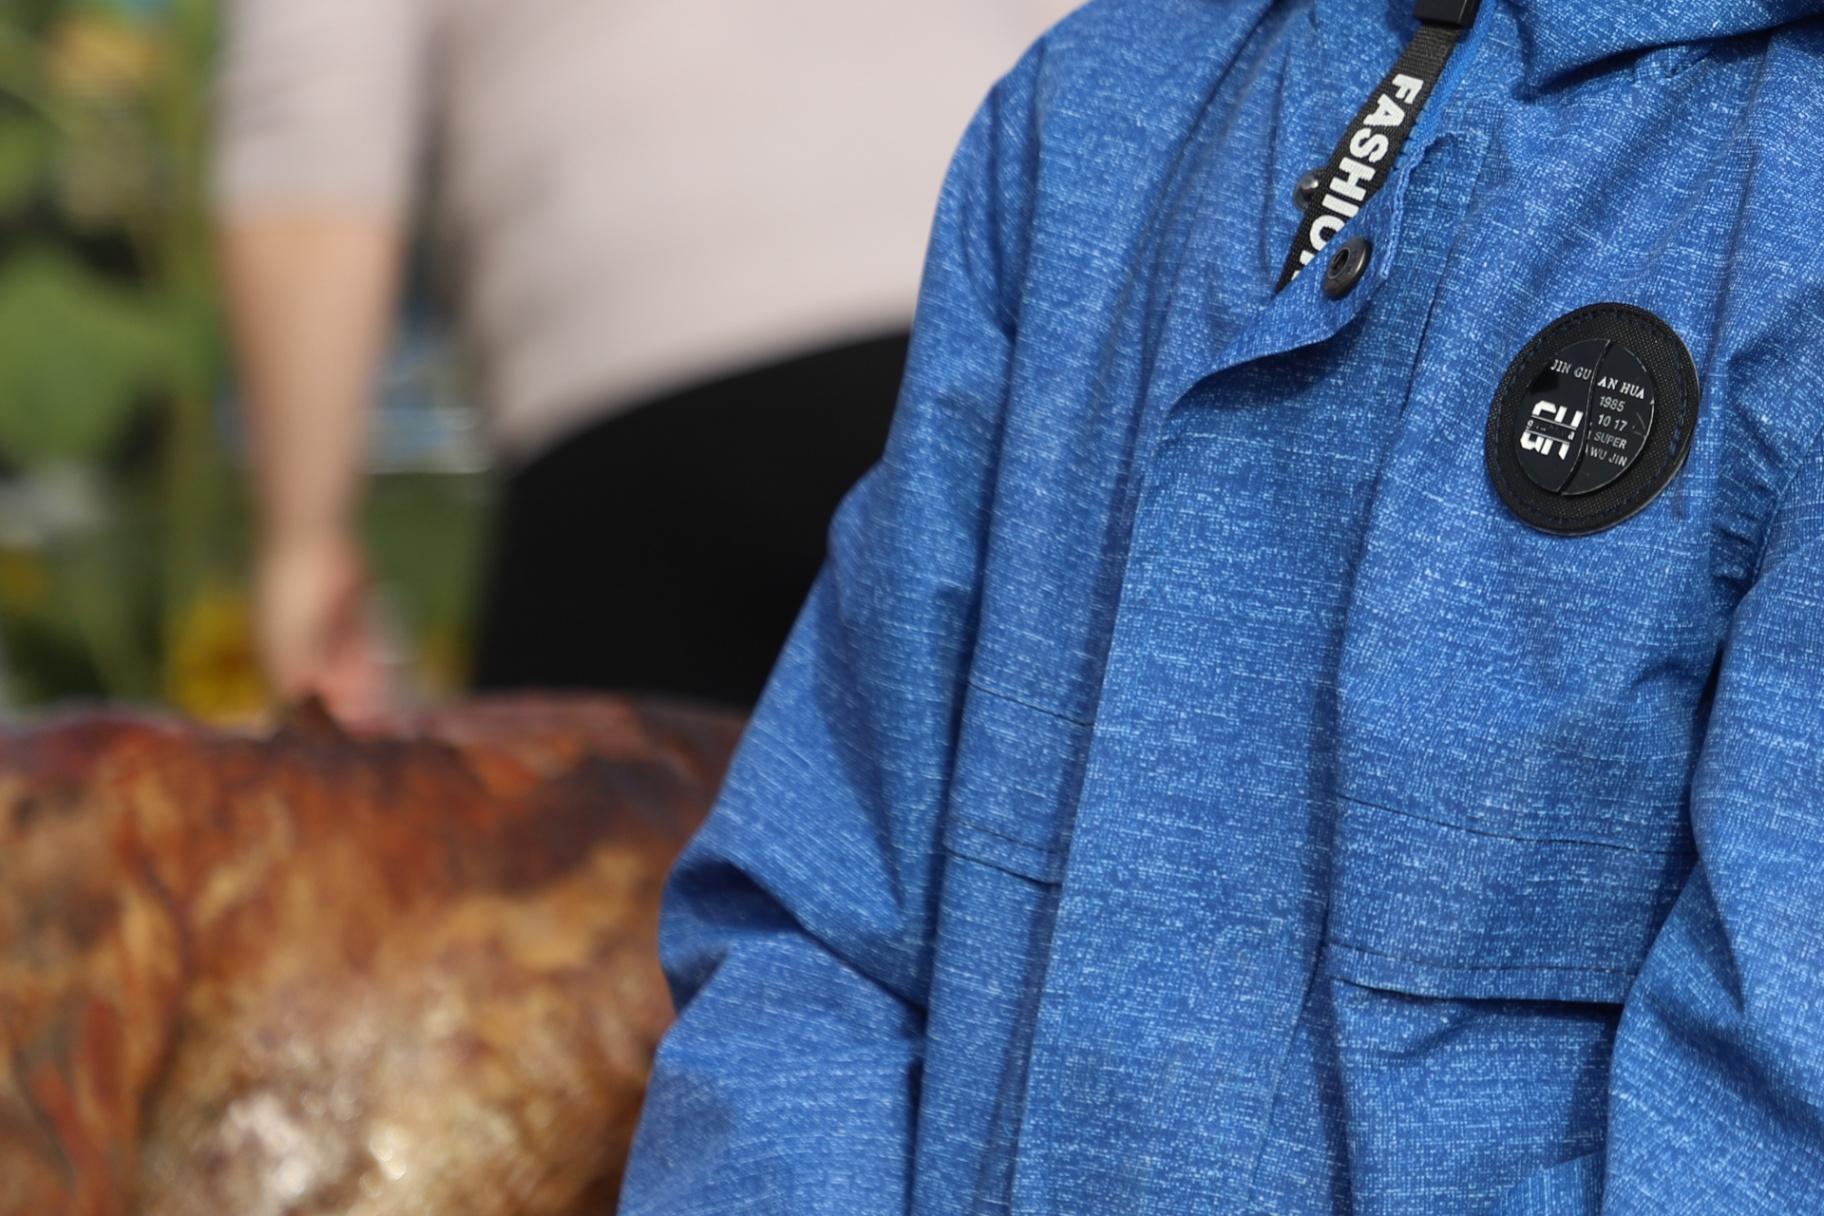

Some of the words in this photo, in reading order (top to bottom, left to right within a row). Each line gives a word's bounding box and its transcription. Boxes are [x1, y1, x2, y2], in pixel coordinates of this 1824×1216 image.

[1291, 73, 1424, 281] FASHIO
[1550, 359, 1571, 375] JIN
[1619, 381, 1645, 400] HUA
[1599, 394, 1626, 413] 1985
[1598, 413, 1612, 428] 10
[1614, 419, 1628, 432] 17
[1593, 431, 1628, 450] SUPER
[1608, 453, 1628, 467] JIN
